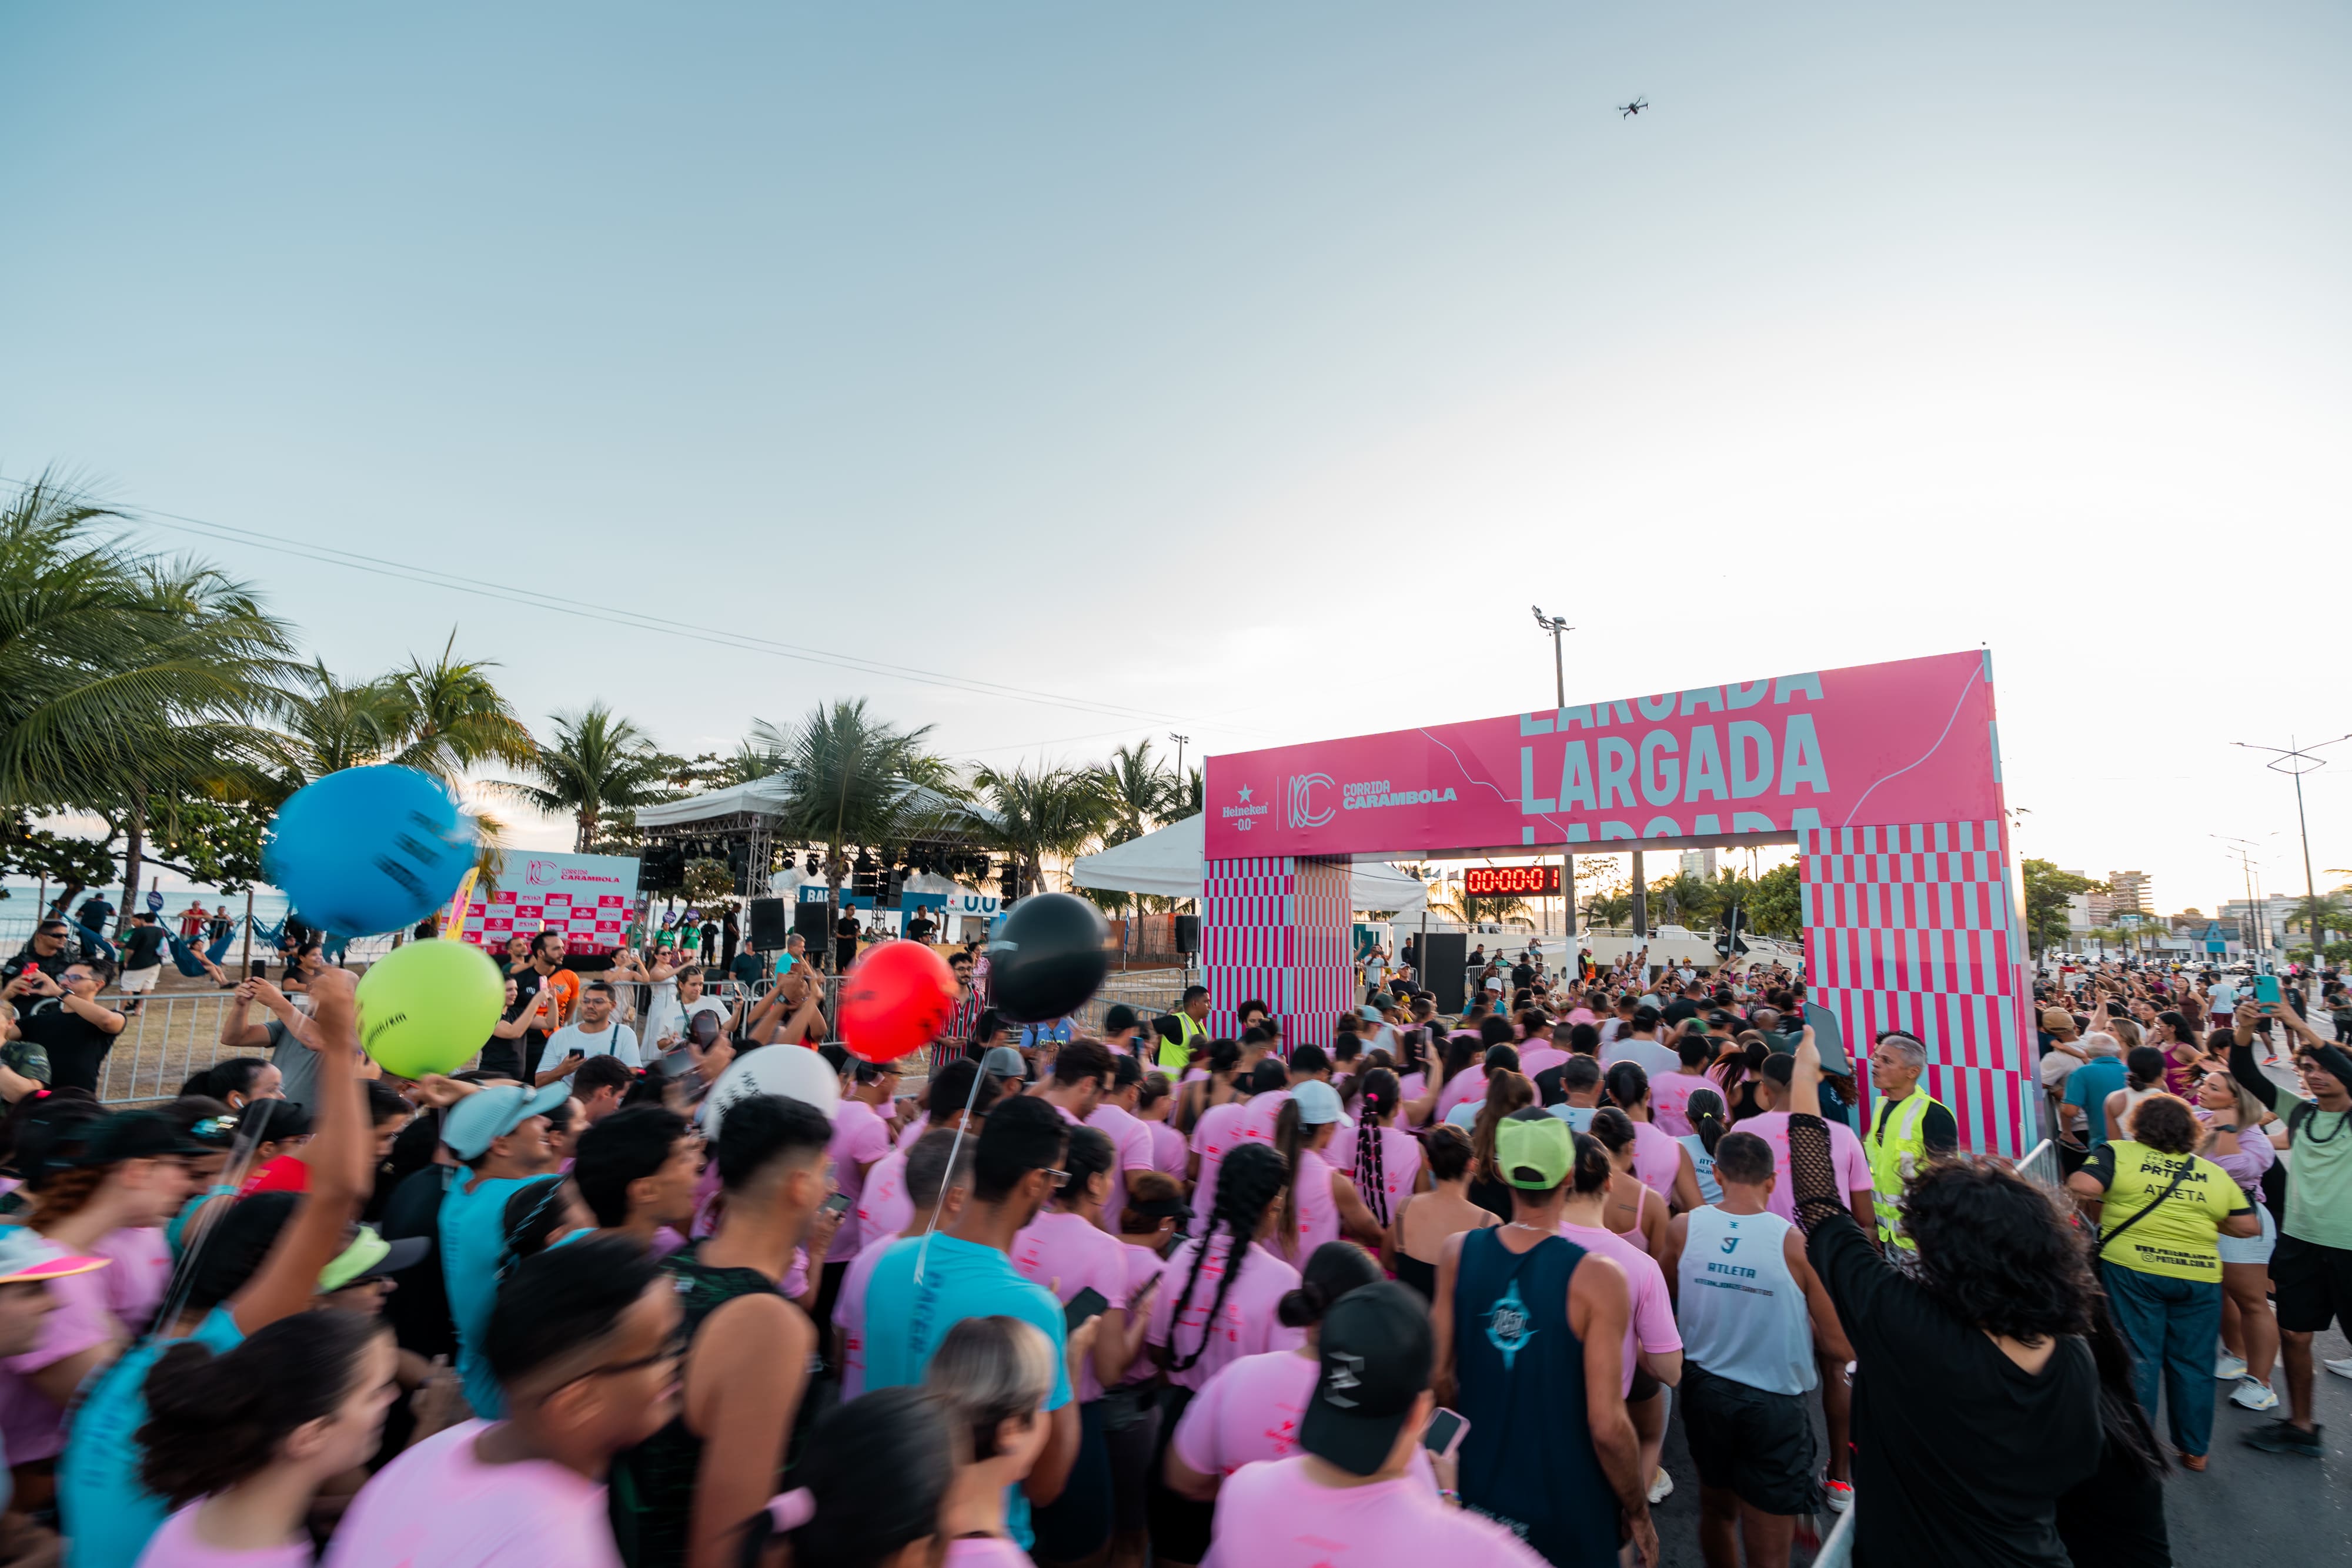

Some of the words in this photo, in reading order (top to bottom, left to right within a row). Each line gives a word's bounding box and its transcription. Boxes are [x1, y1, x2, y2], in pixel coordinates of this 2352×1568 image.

[1521, 713, 1830, 815] LARGADA
[1343, 780, 1391, 797] CORRIDA
[1342, 787, 1458, 810] CARAMBOLA
[1222, 804, 1268, 818] Heineken
[560, 875, 620, 883] CARAMBOLA
[1468, 868, 1559, 892] 00:00:01
[1708, 1262, 1756, 1279] ATLETA
